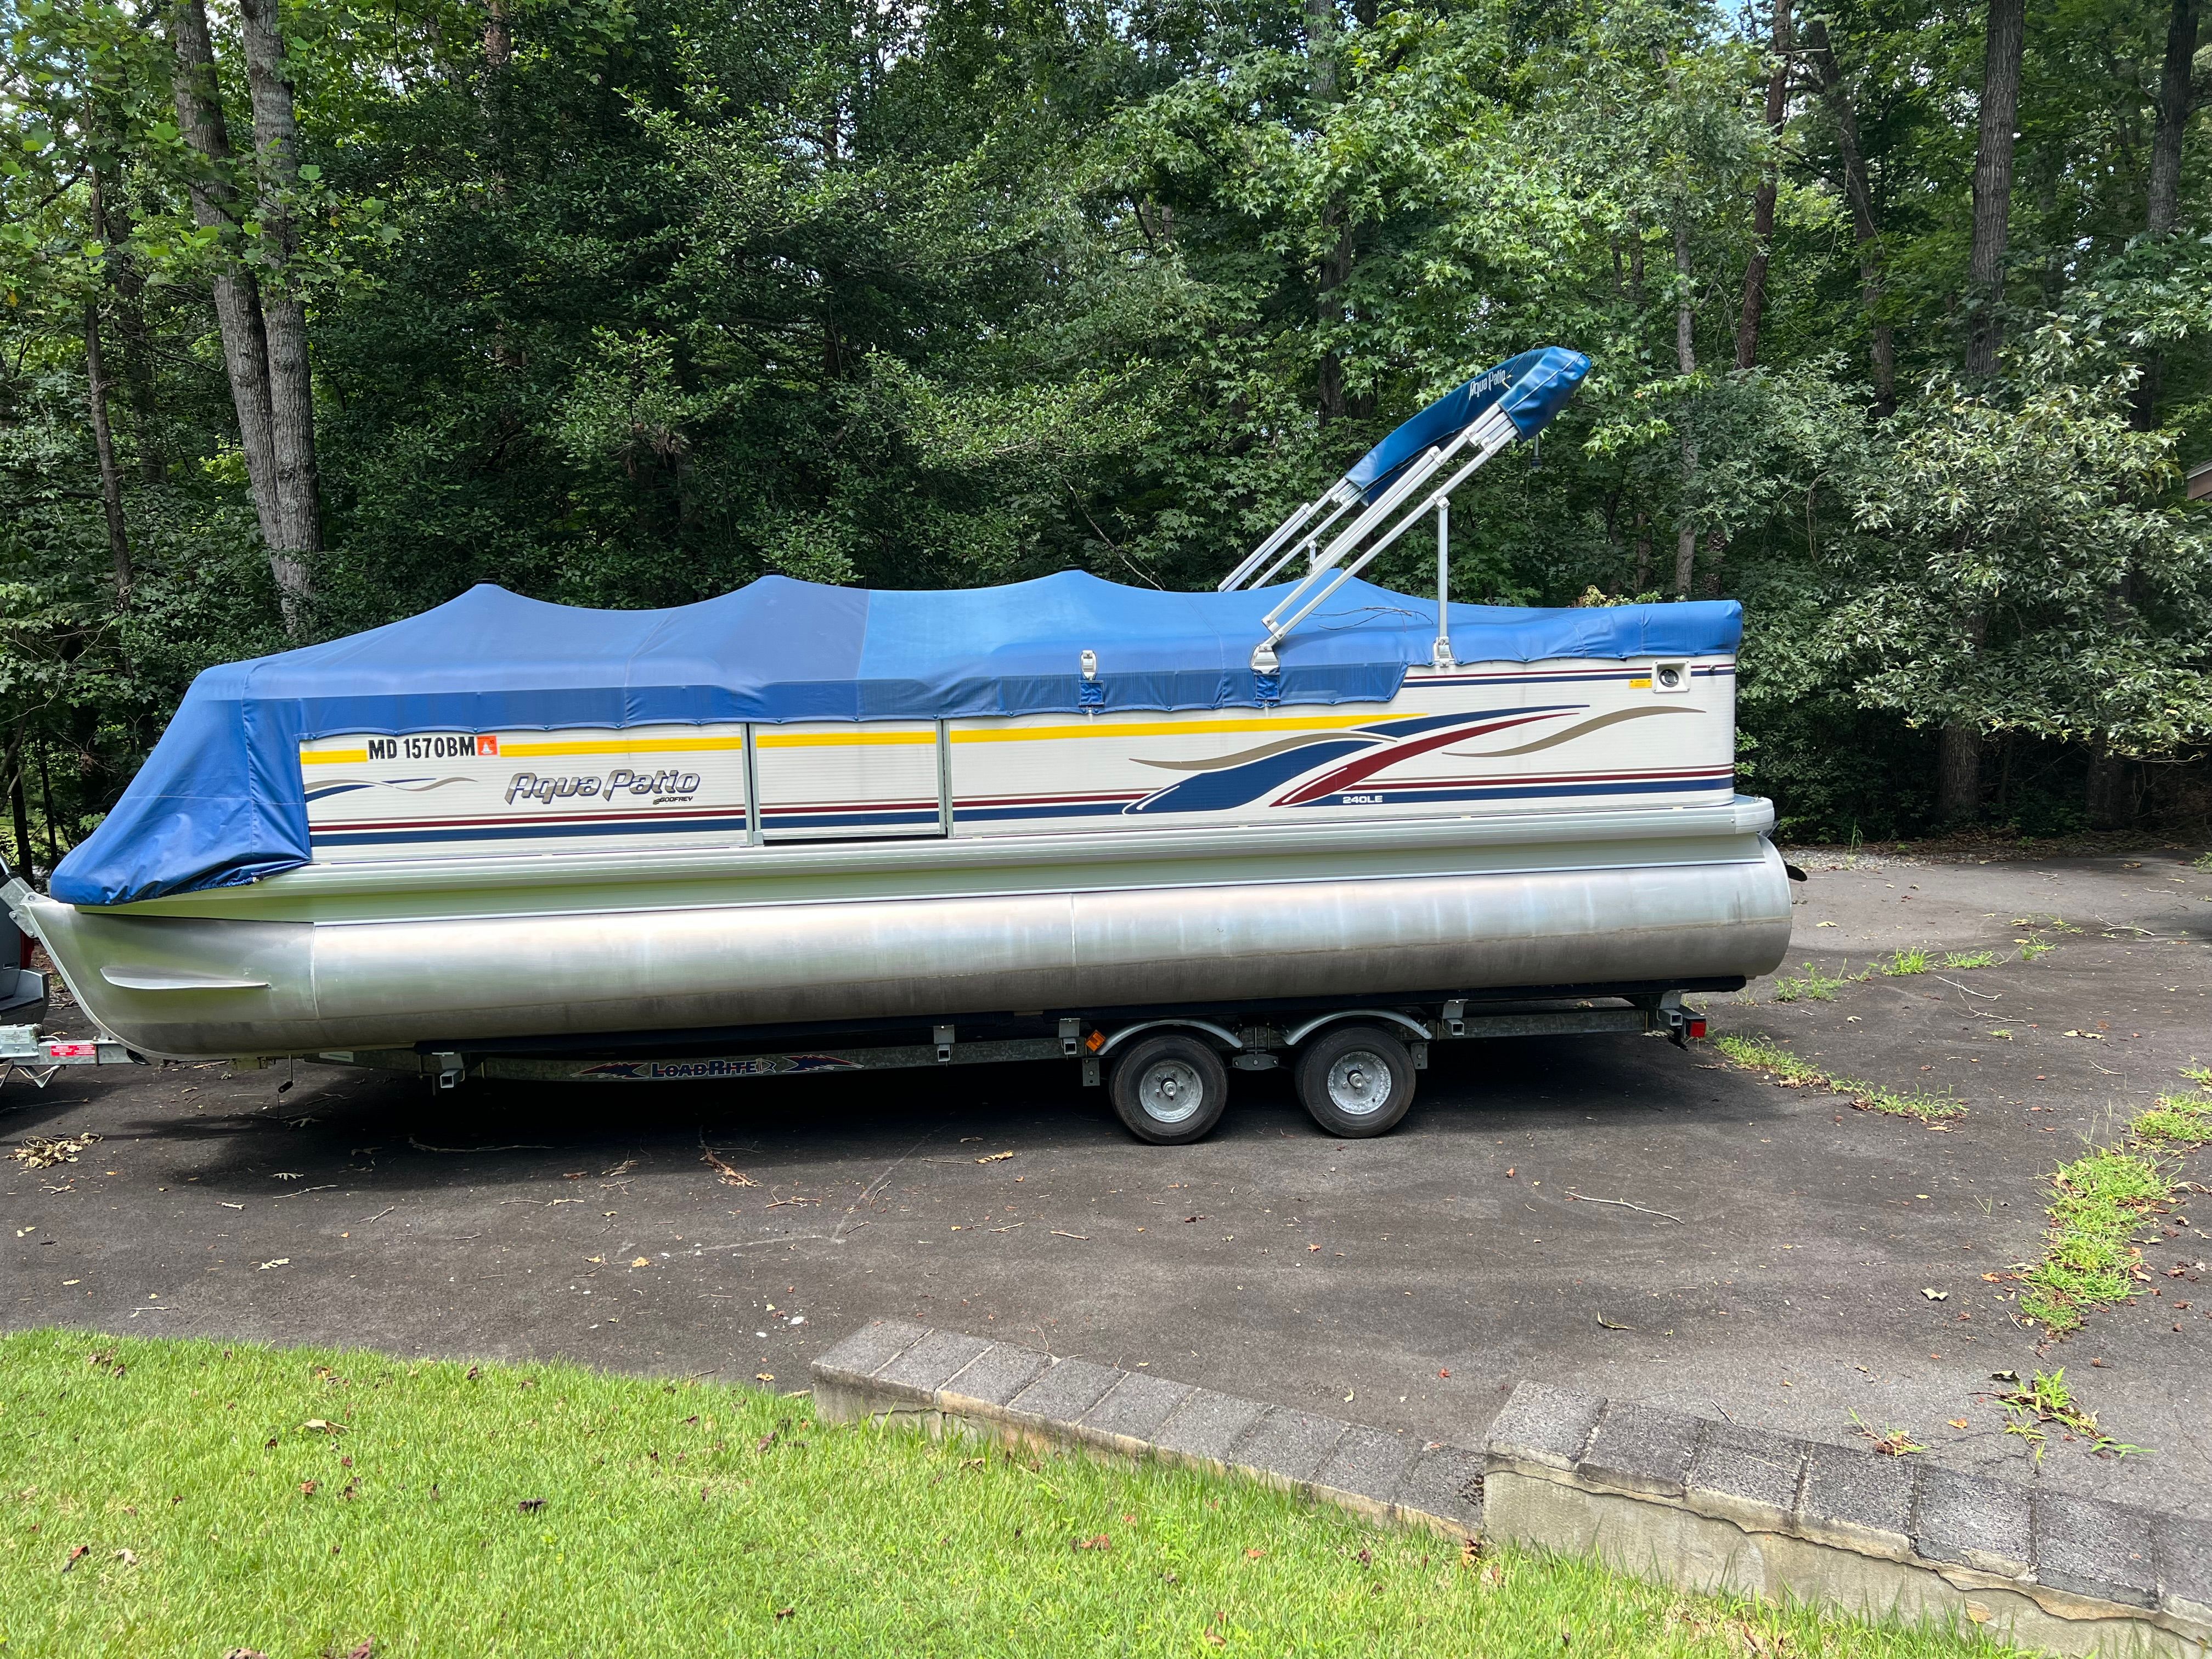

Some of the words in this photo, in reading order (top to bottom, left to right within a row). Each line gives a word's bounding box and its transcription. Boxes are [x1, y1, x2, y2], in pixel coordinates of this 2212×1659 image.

[1469, 377, 1488, 401] Aqua
[1488, 369, 1506, 391] Patio
[368, 739, 398, 760] MD
[403, 736, 476, 759] 1570BM
[504, 772, 601, 805] Aqua
[602, 769, 701, 802] Patio
[1342, 795, 1383, 804] 240LE
